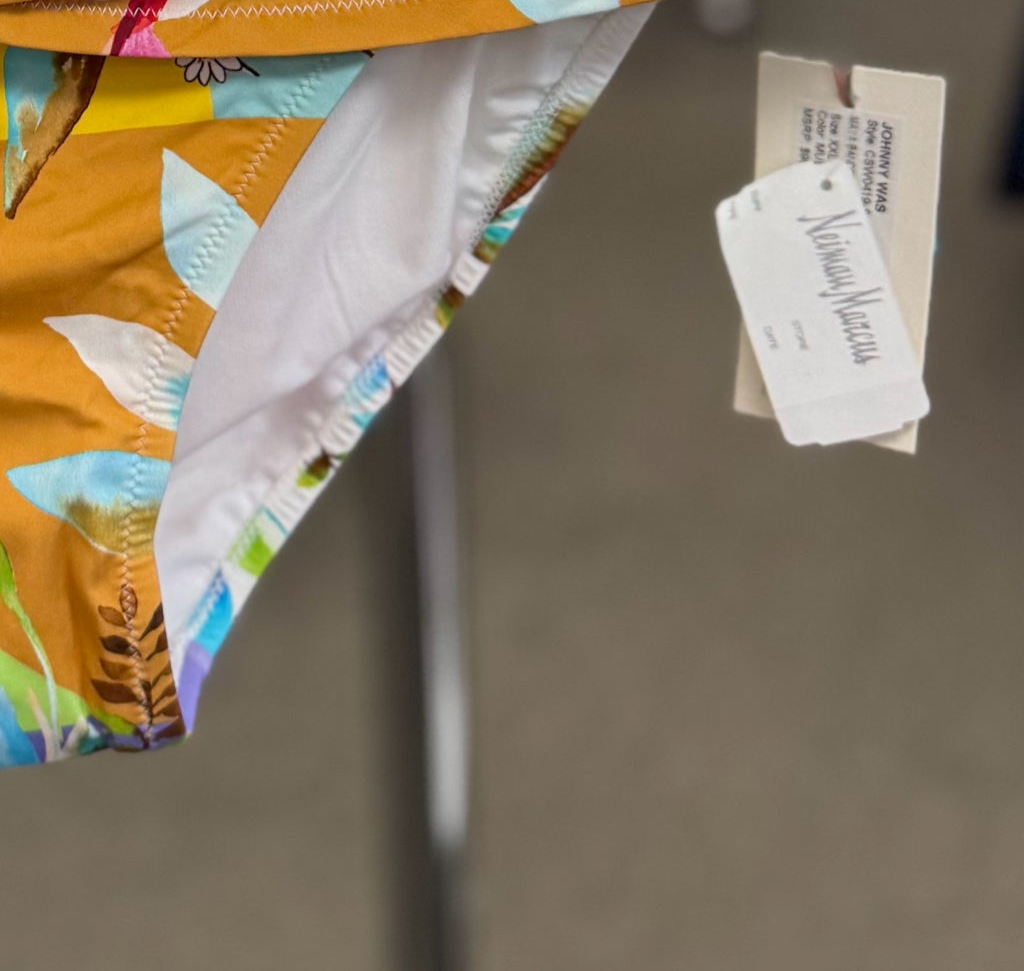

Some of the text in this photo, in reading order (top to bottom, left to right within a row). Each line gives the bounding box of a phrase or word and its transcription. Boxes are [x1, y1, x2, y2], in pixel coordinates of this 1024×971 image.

[802, 107, 814, 141] MSRP
[816, 110, 827, 138] Color
[827, 114, 842, 161] Size XXL
[864, 119, 878, 145] Style
[875, 122, 893, 213] JOHNNY WAS
[796, 209, 883, 366] Neiman Marcus
